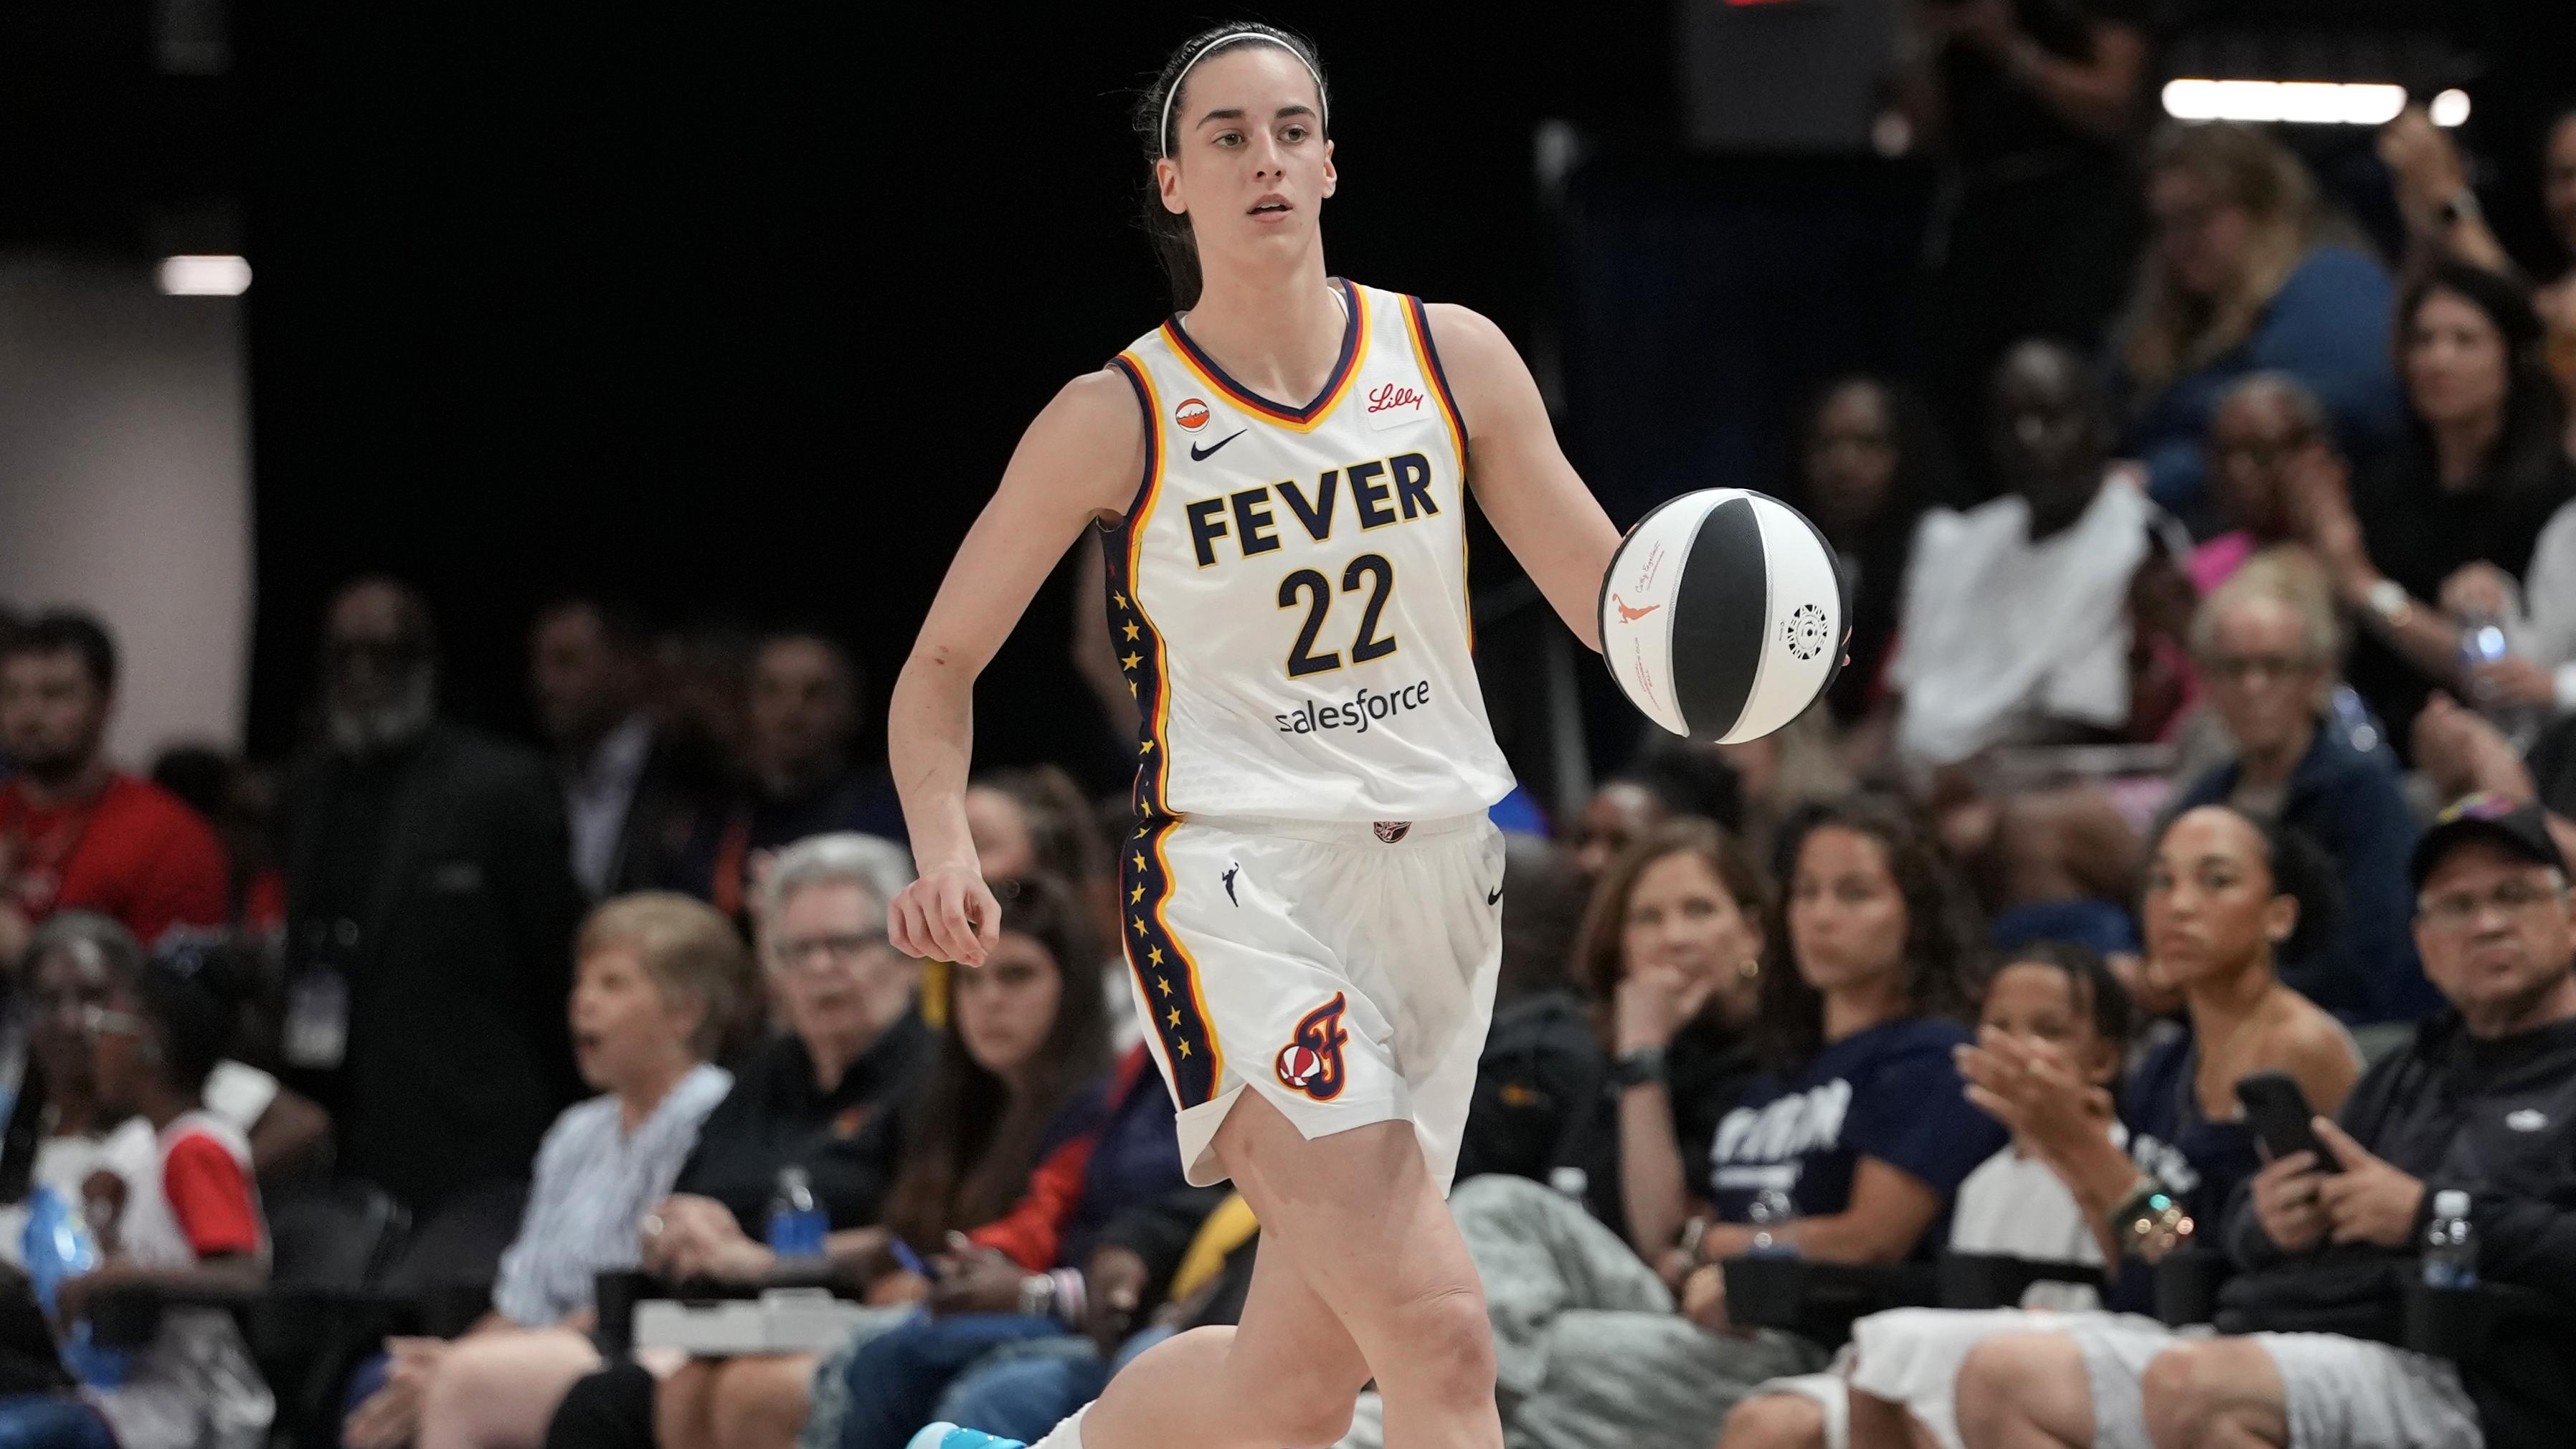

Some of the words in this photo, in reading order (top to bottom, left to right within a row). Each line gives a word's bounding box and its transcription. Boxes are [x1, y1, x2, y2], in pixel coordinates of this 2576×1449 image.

[1368, 383, 1424, 413] Lilly
[1185, 452, 1441, 569] FEVER
[1277, 554, 1398, 680] 22
[1274, 680, 1430, 733] salesforce
